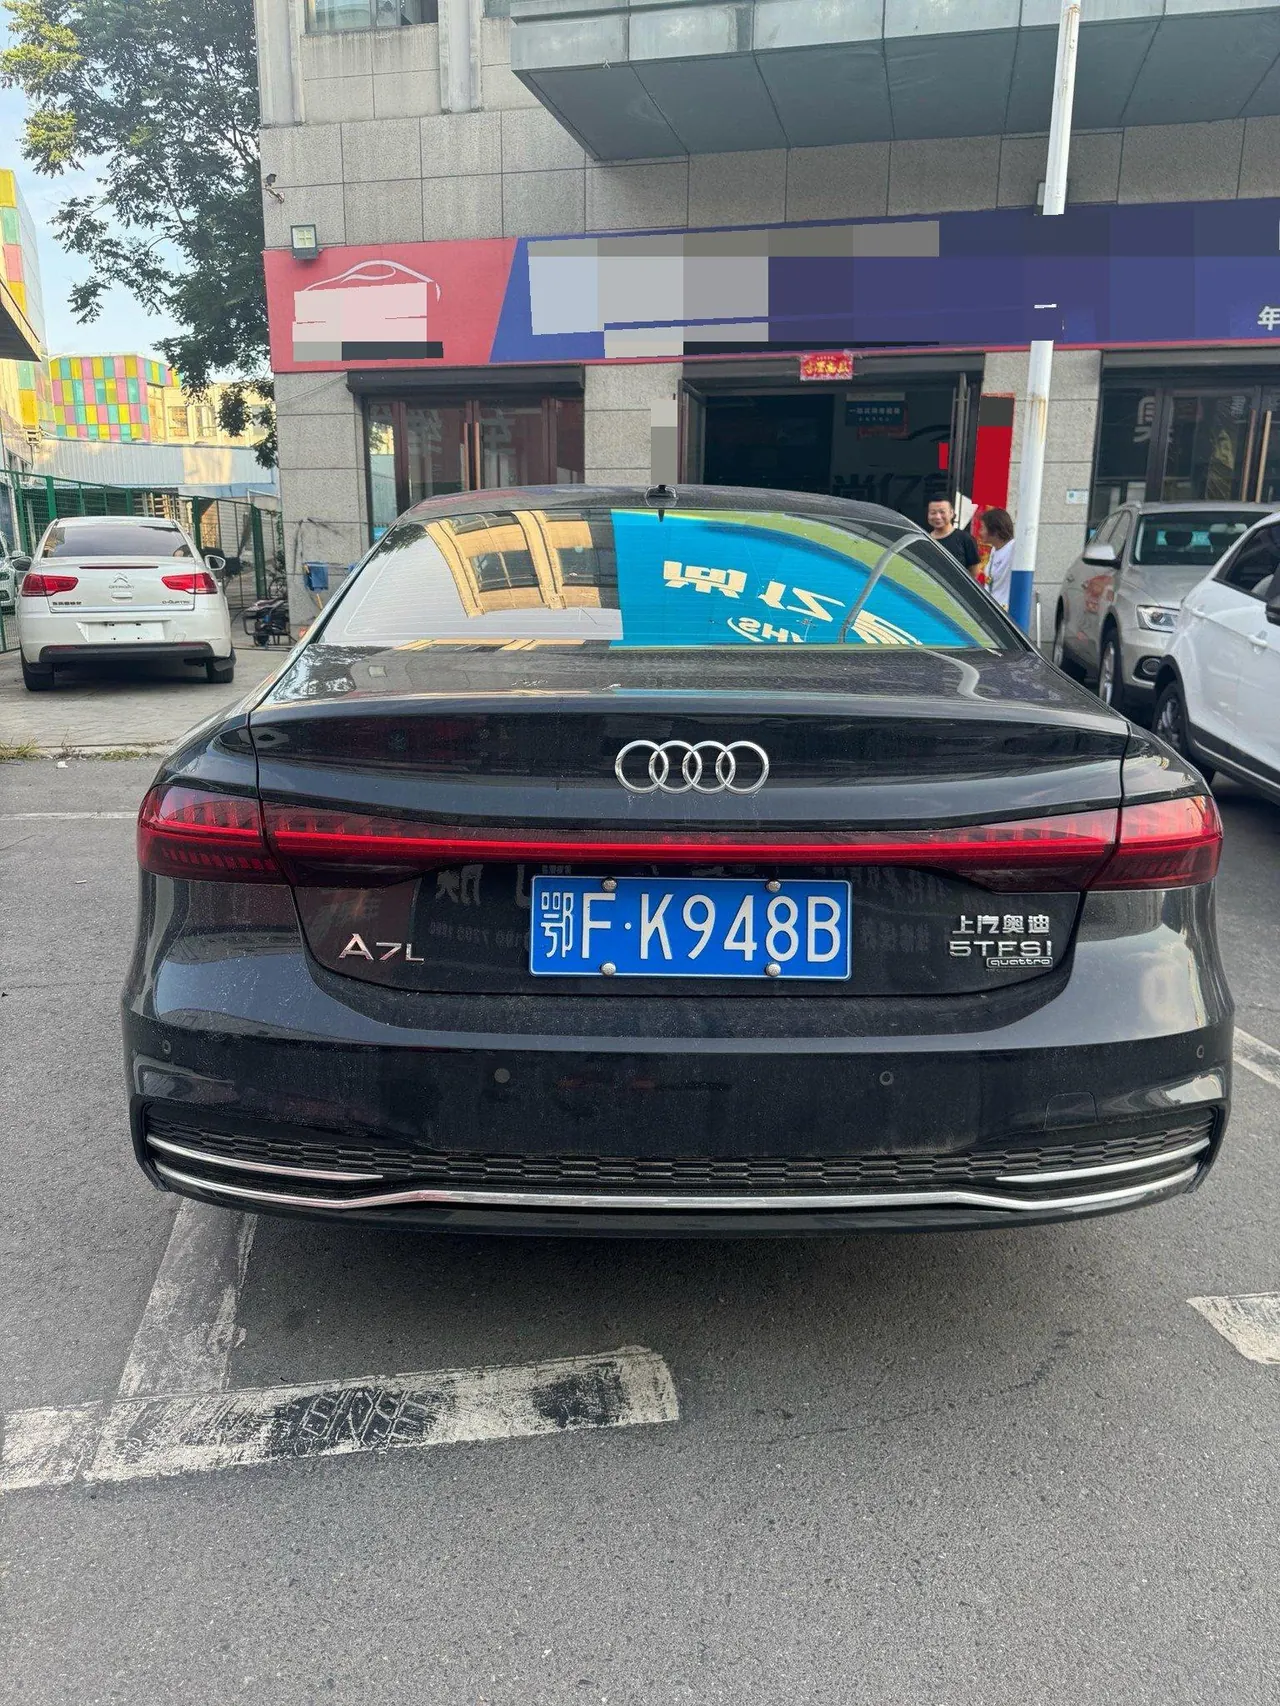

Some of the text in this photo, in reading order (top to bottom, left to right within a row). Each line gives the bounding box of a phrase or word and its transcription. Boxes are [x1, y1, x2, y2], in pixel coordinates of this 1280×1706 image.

[540, 891, 842, 963] 鄂F·K948B
[952, 914, 1050, 935] 上汽奥迪
[338, 933, 425, 963] A7L
[949, 940, 1052, 957] 5TFSI
[988, 957, 1052, 968] quattro
